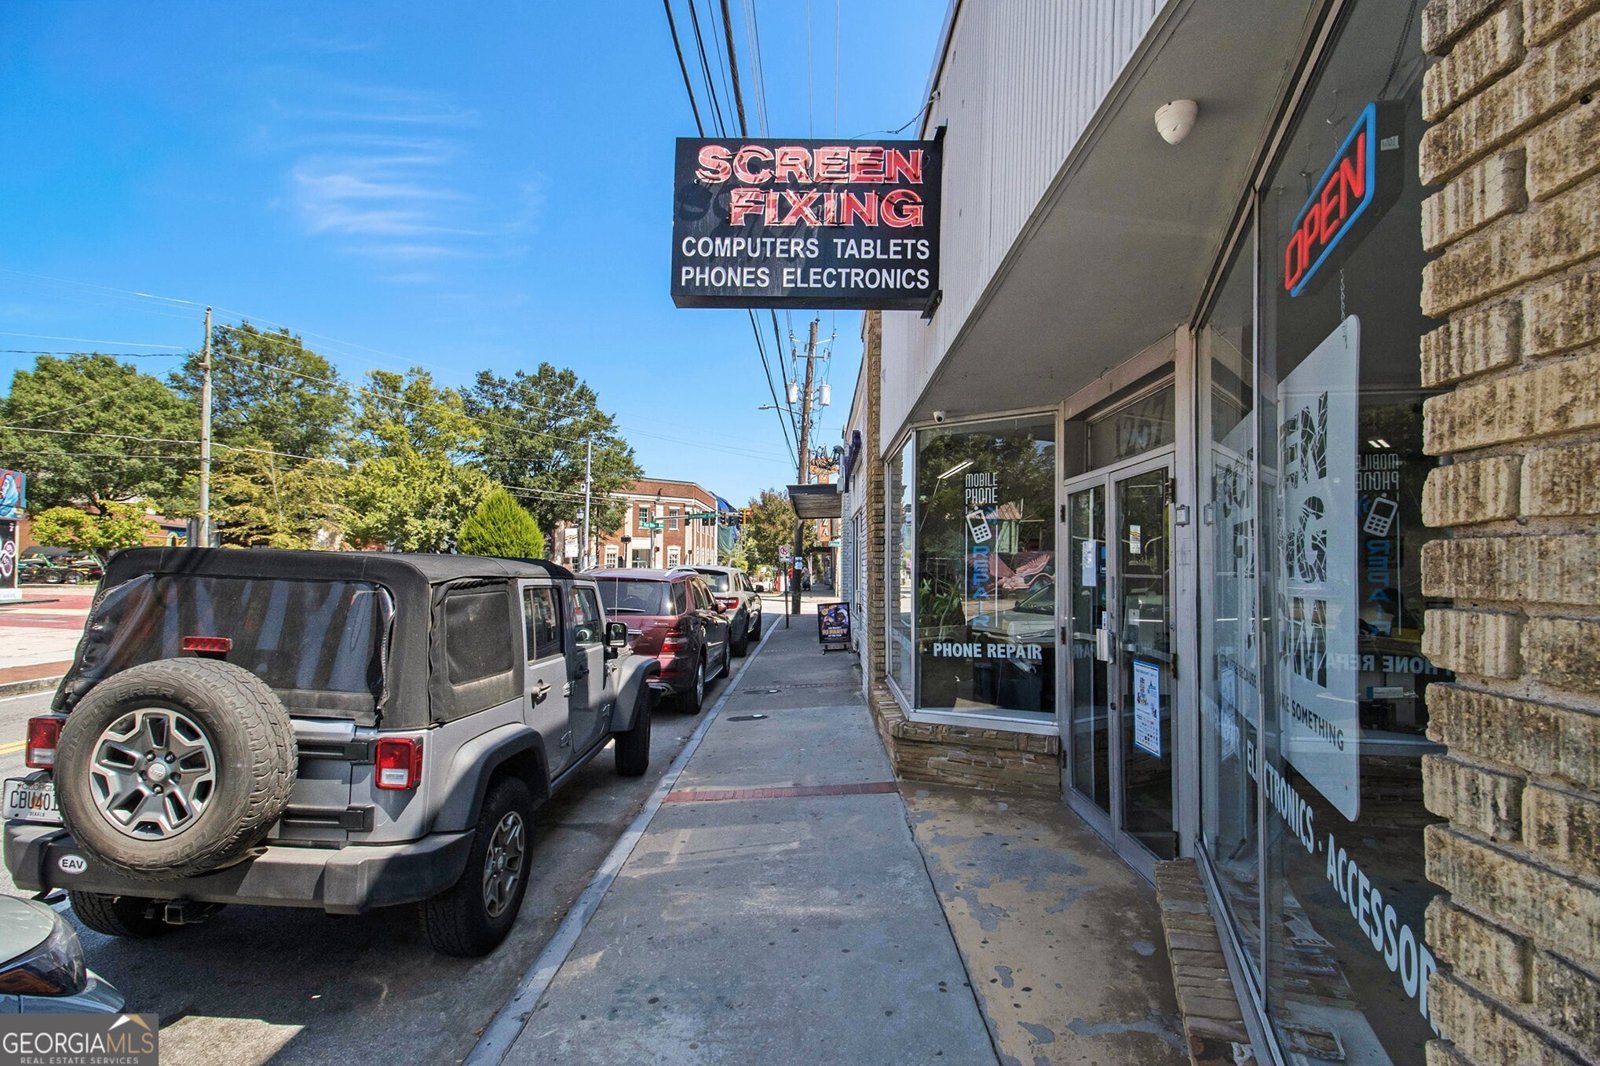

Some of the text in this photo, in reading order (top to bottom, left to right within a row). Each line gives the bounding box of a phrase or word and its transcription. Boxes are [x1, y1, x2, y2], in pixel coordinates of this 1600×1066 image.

[694, 144, 924, 184] SCREEN
[729, 187, 924, 228] FIXING
[1284, 132, 1366, 290] OPEN
[681, 236, 930, 260] COMPUTERS TABLETS
[681, 266, 929, 289] PHONES ELECTRONICS
[965, 473, 998, 488] MOBILE
[965, 487, 998, 504] PHONE
[933, 642, 1043, 660] PHONE REPAIR
[1291, 699, 1344, 752] SOMETHING
[62, 859, 84, 869] EAV
[1246, 738, 1447, 1039] ELCTRONICS ACCESSOR
